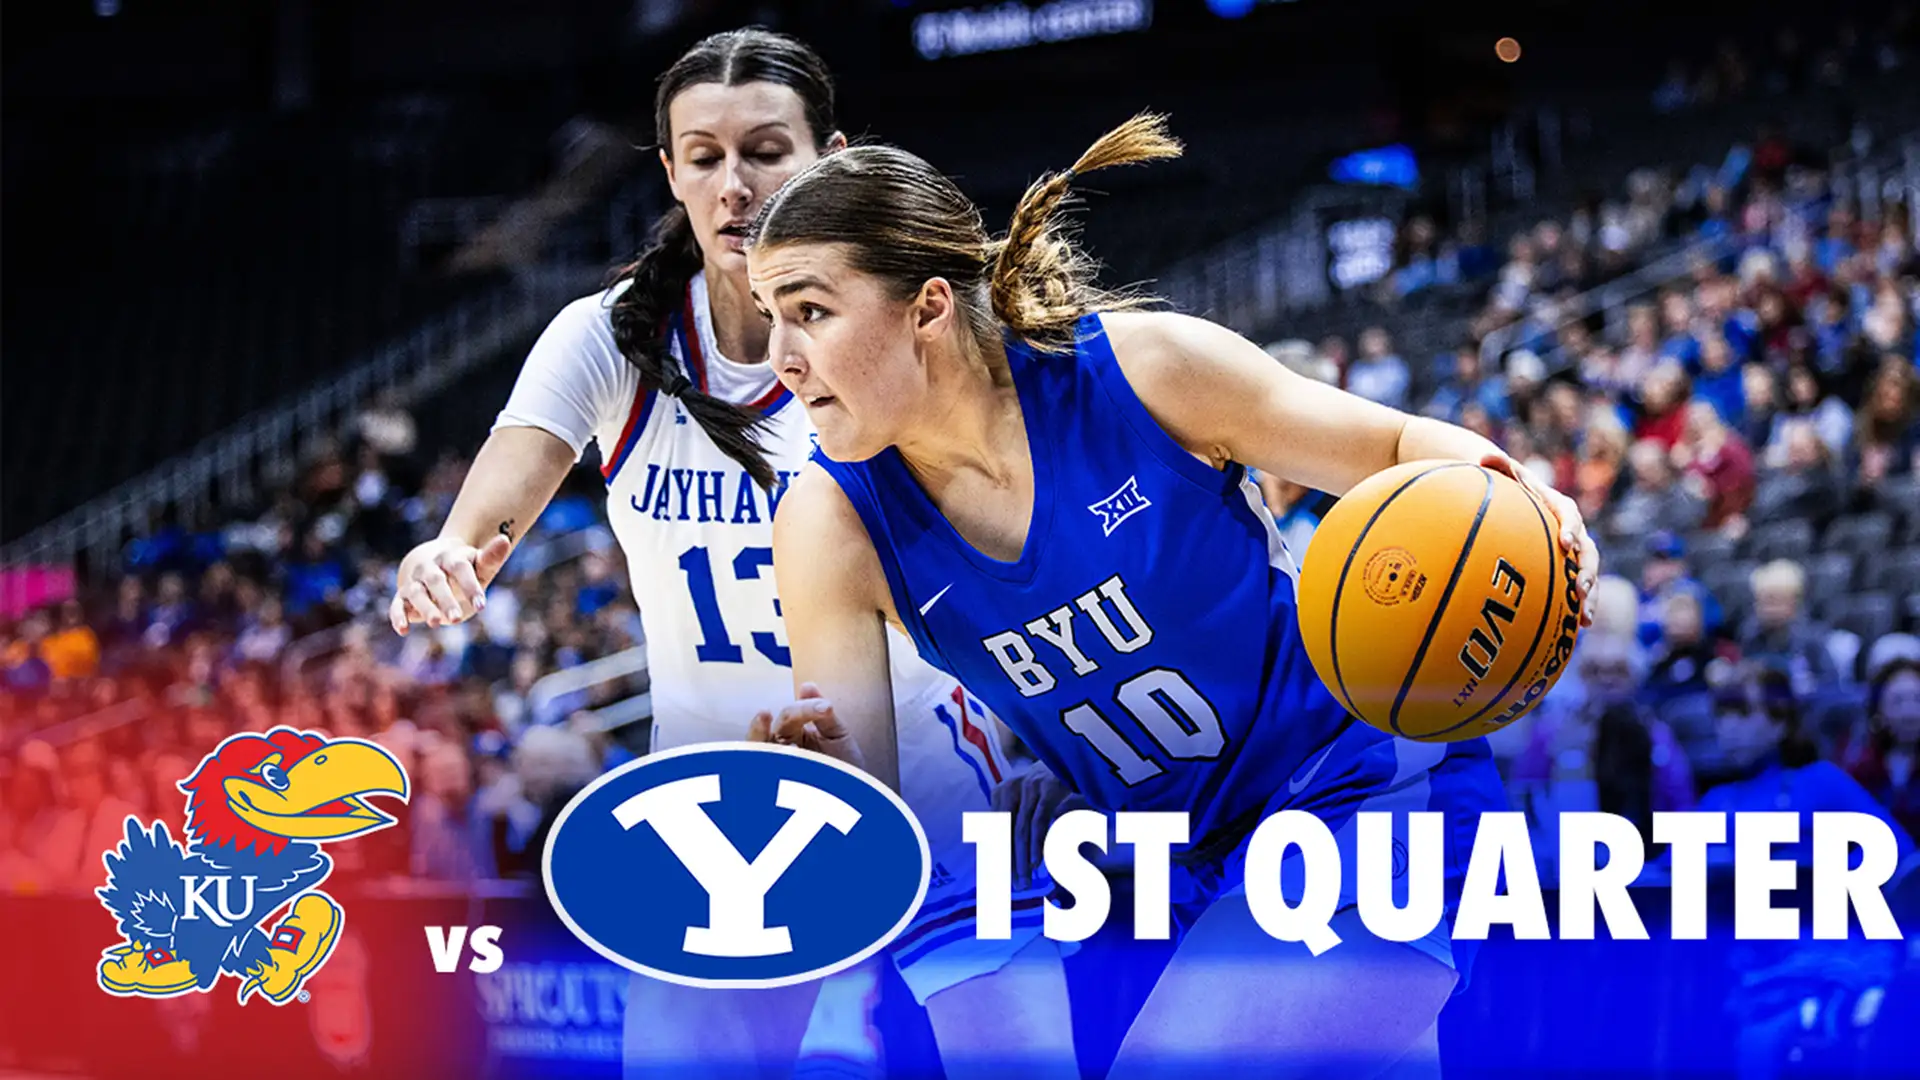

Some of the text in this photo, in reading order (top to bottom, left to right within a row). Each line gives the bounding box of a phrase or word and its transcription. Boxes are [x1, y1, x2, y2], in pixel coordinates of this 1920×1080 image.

[981, 572, 1155, 698] BYU
[1458, 556, 1526, 680] EVO
[1059, 665, 1231, 789] 10
[1453, 677, 1479, 708] NXT
